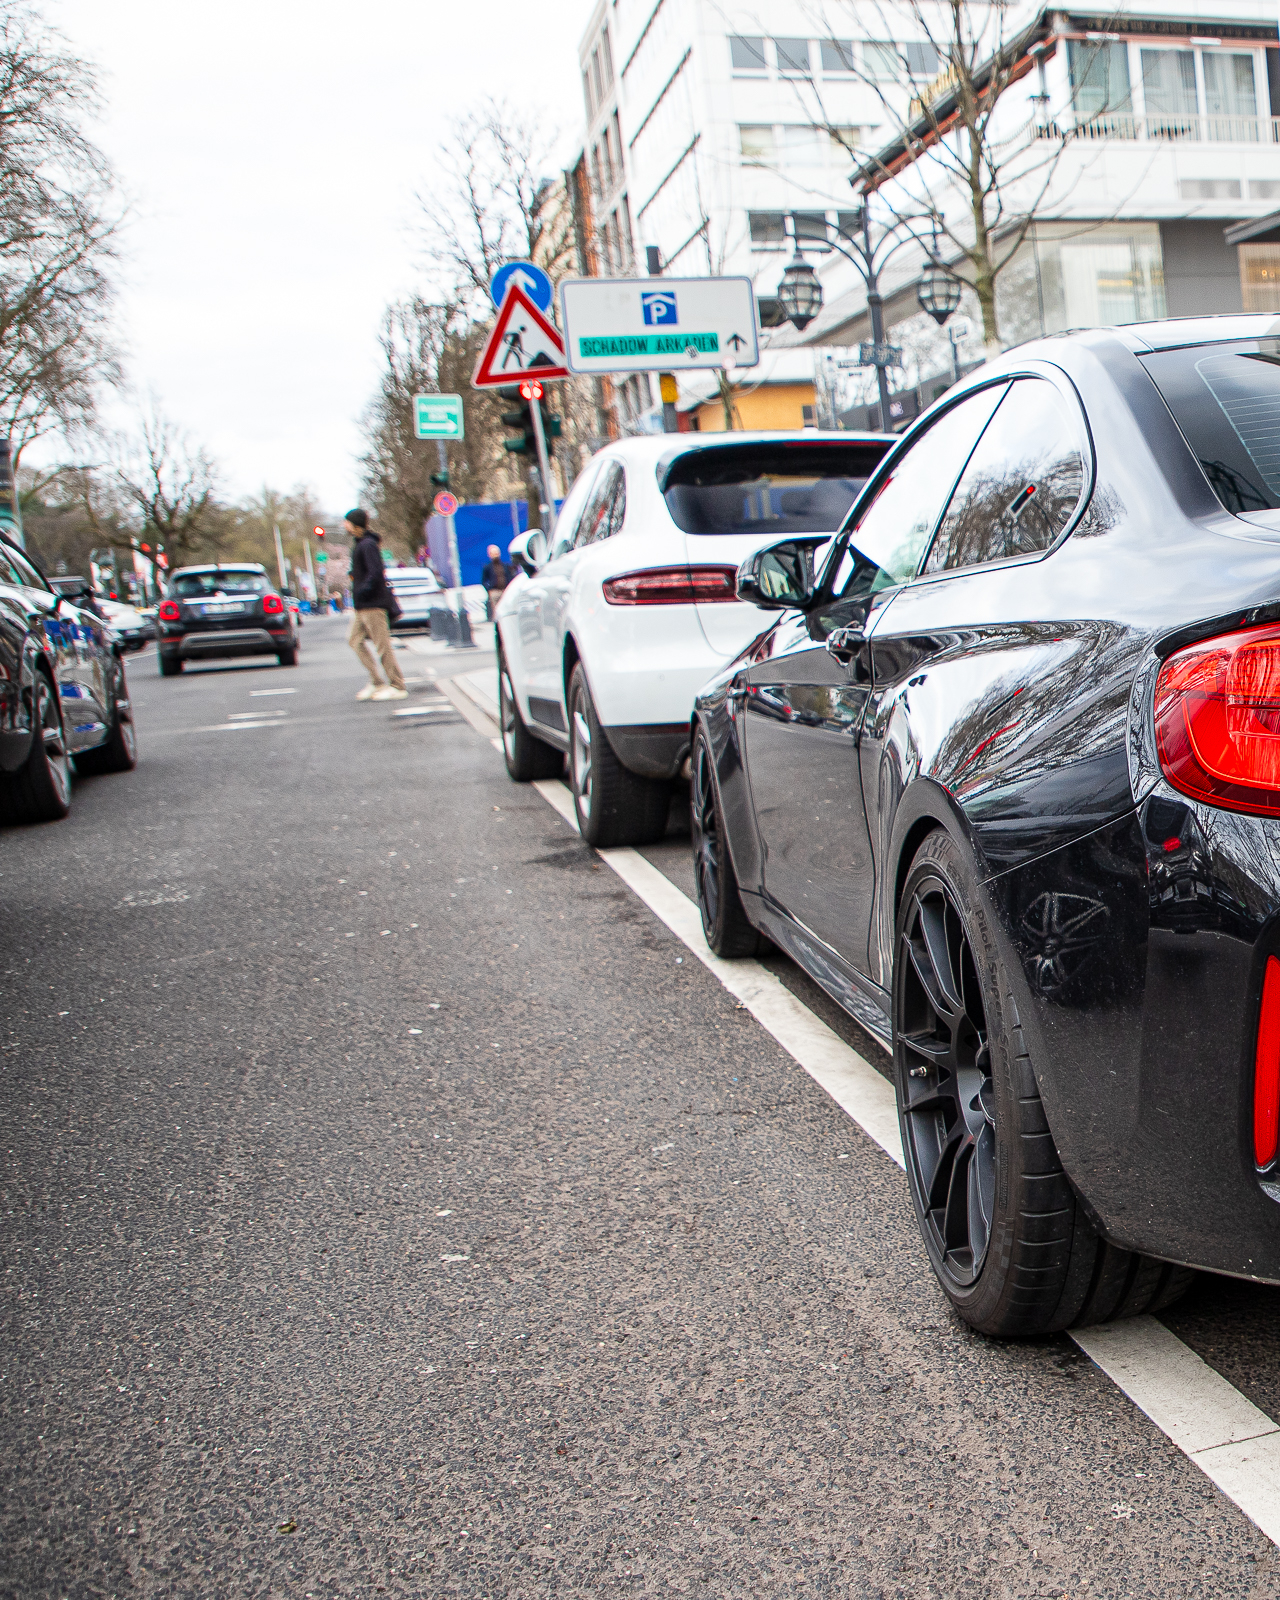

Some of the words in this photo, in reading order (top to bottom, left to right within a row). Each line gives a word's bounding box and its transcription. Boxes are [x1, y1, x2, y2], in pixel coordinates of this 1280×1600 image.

[651, 302, 668, 324] P
[583, 339, 649, 356] SCHADOW
[656, 335, 719, 354] ARKADEN
[975, 911, 993, 953] Pilot
